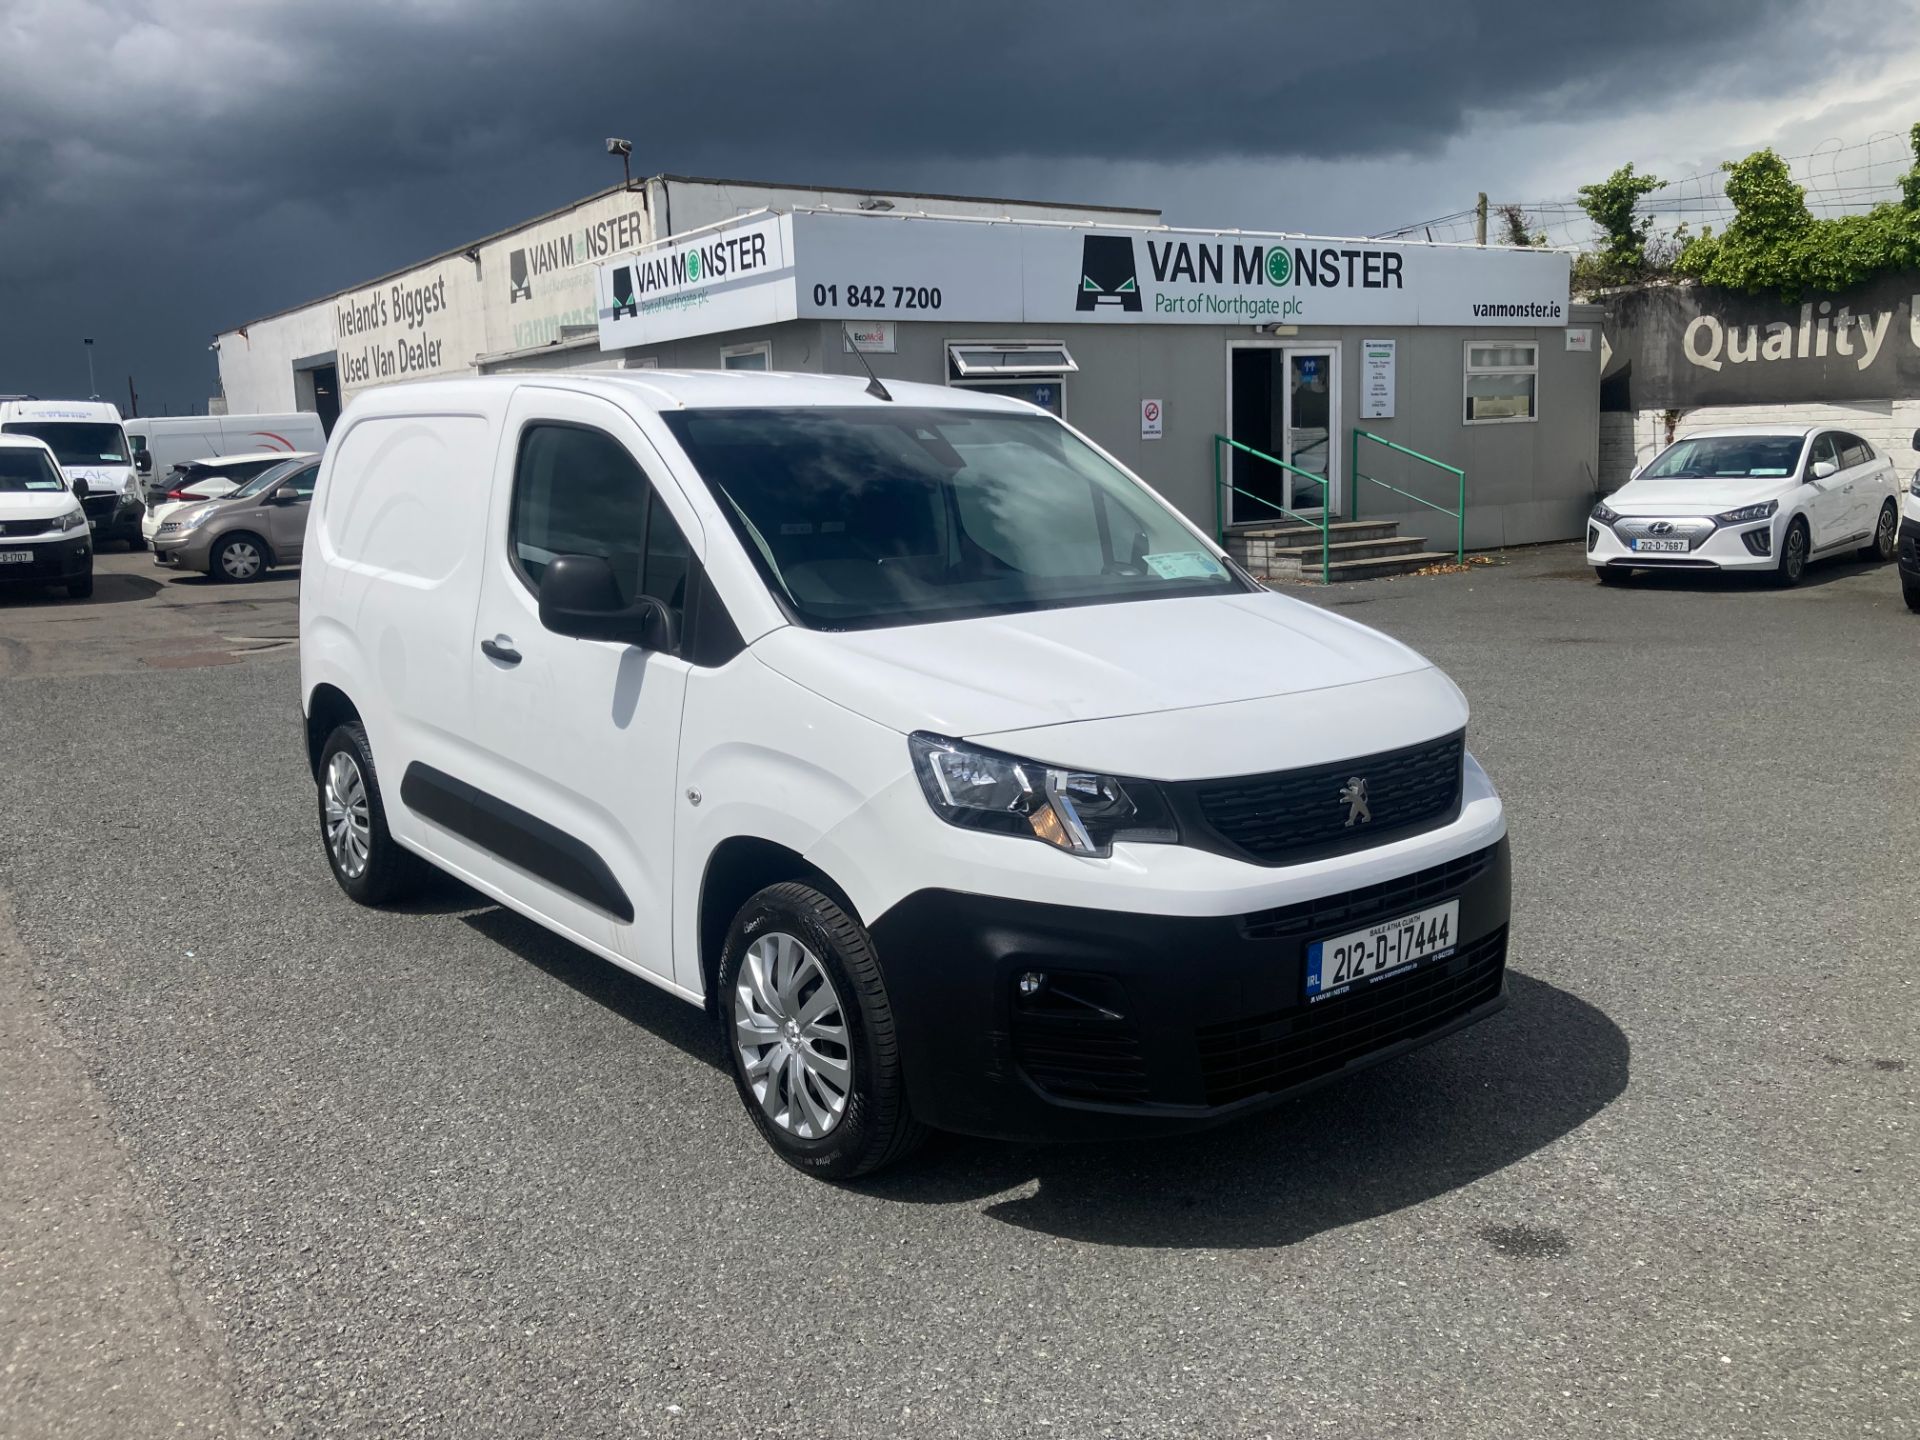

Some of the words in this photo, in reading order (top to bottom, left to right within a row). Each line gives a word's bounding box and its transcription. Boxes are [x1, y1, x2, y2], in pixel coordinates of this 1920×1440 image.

[529, 239, 559, 276] VAN
[636, 257, 669, 293] VAN
[672, 232, 767, 287] MONSTER
[1147, 240, 1224, 284] VAN
[1233, 245, 1404, 289] MONSTER
[337, 290, 388, 338] Ireland's
[392, 273, 447, 330] Biggest
[813, 283, 838, 307] 01
[847, 285, 886, 308] 842
[892, 286, 942, 309] 7200
[1155, 293, 1185, 313] Part
[1187, 293, 1204, 313] of
[1206, 294, 1280, 319] Northgate
[1283, 295, 1303, 319] plc
[1473, 300, 1561, 318] vanmonster.ie
[342, 346, 370, 384] Used
[372, 344, 396, 378] Van
[398, 331, 442, 374] Dealer
[1683, 300, 1892, 372] Quality
[1641, 541, 1684, 551] 212-D-7687
[1332, 912, 1450, 985] 212-D-17444
[1307, 973, 1320, 988] IRL
